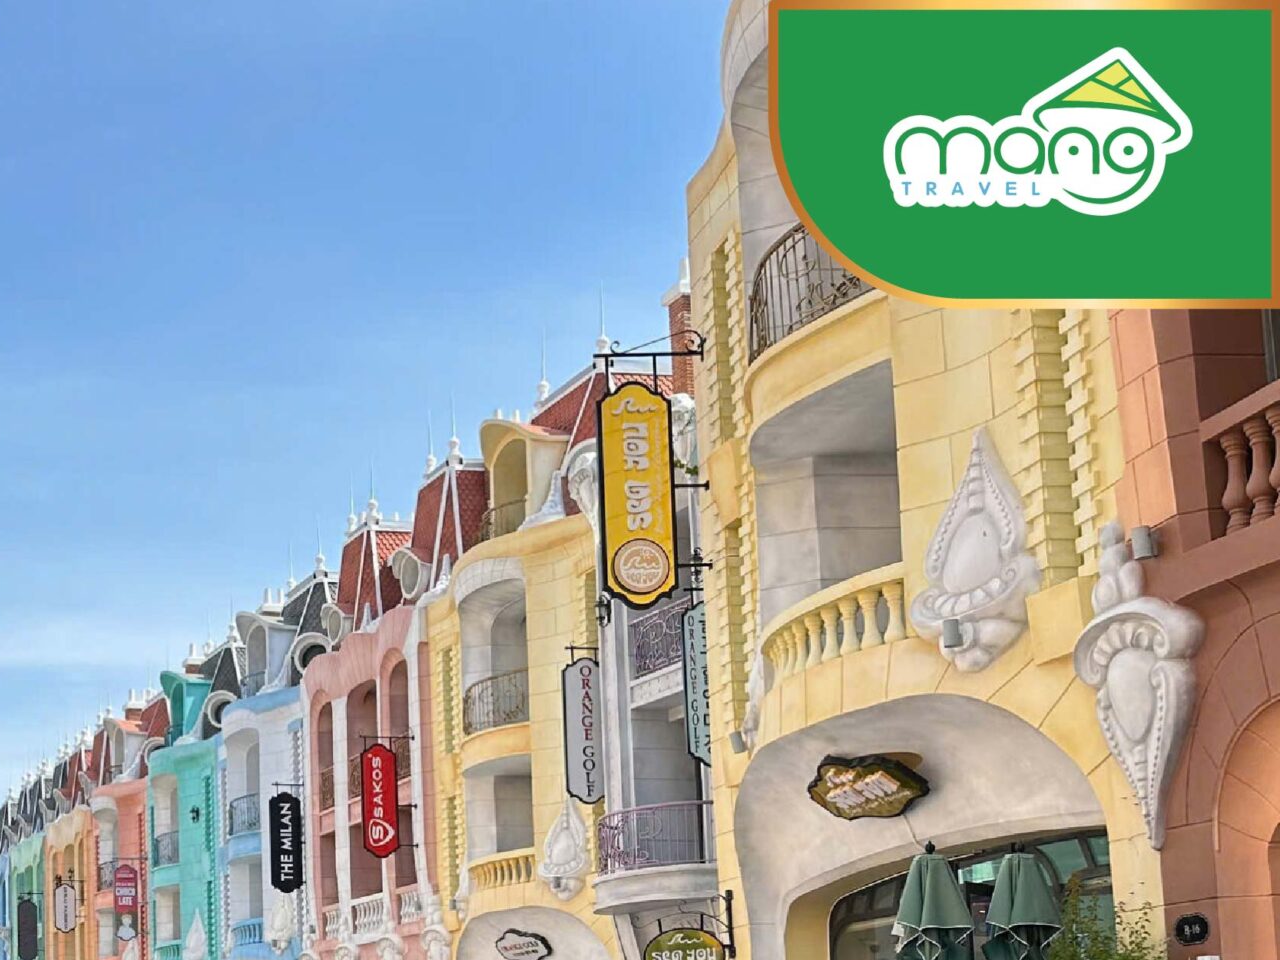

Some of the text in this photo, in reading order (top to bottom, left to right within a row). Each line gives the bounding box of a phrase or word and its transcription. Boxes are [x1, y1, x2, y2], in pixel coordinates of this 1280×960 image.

[579, 665, 596, 798] ORANGE GOLF
[688, 615, 700, 754] ORANGE GOLF
[372, 756, 384, 818] SAKOS
[279, 803, 294, 881] THE MILAN
